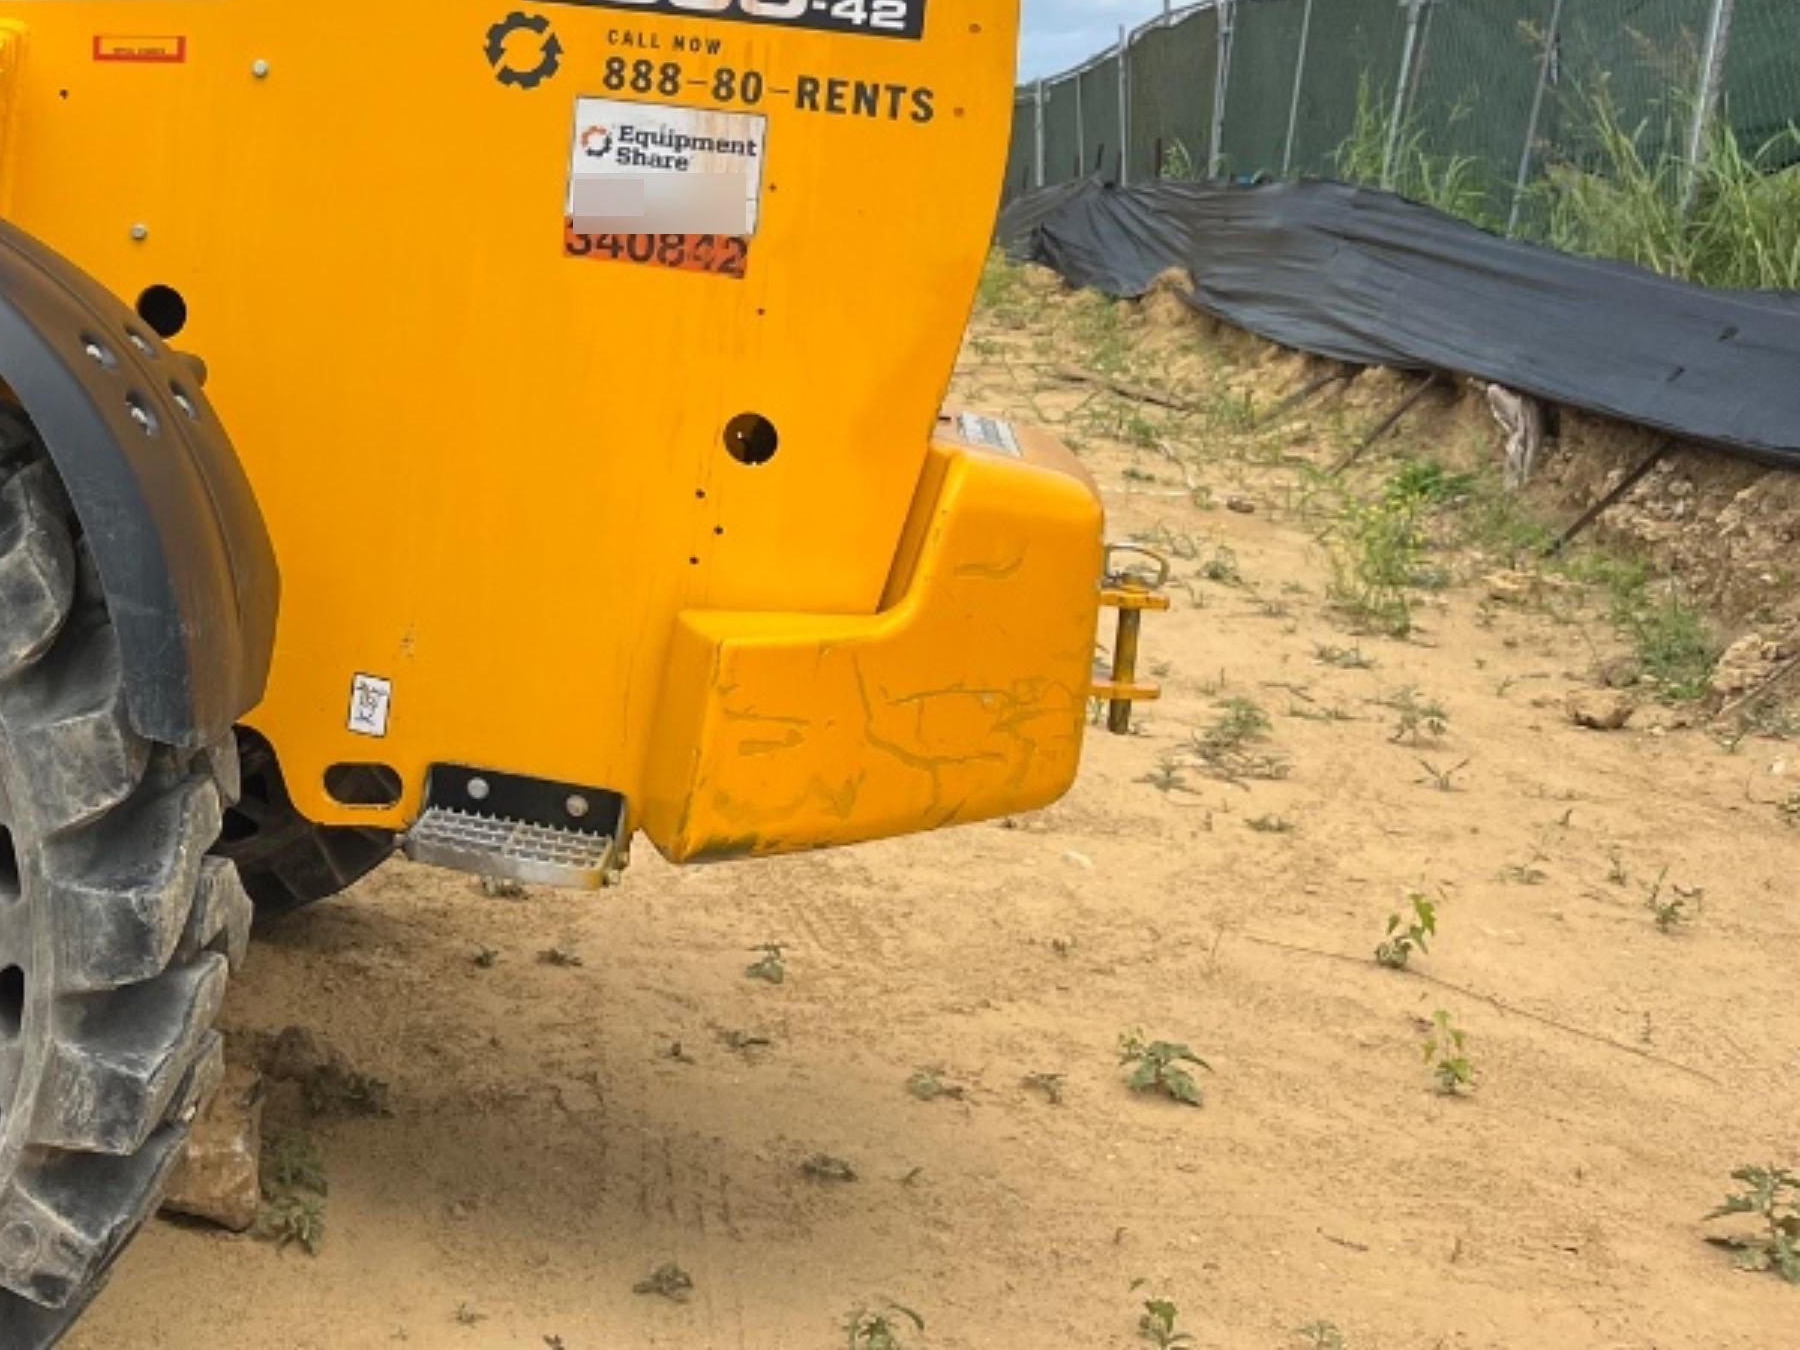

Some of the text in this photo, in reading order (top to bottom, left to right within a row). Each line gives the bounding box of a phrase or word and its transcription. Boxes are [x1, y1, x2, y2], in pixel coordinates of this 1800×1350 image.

[607, 28, 723, 56] CALL NOW
[602, 56, 936, 124] 888-80-RENTS
[616, 125, 758, 157] Equipment
[615, 146, 690, 172] Share
